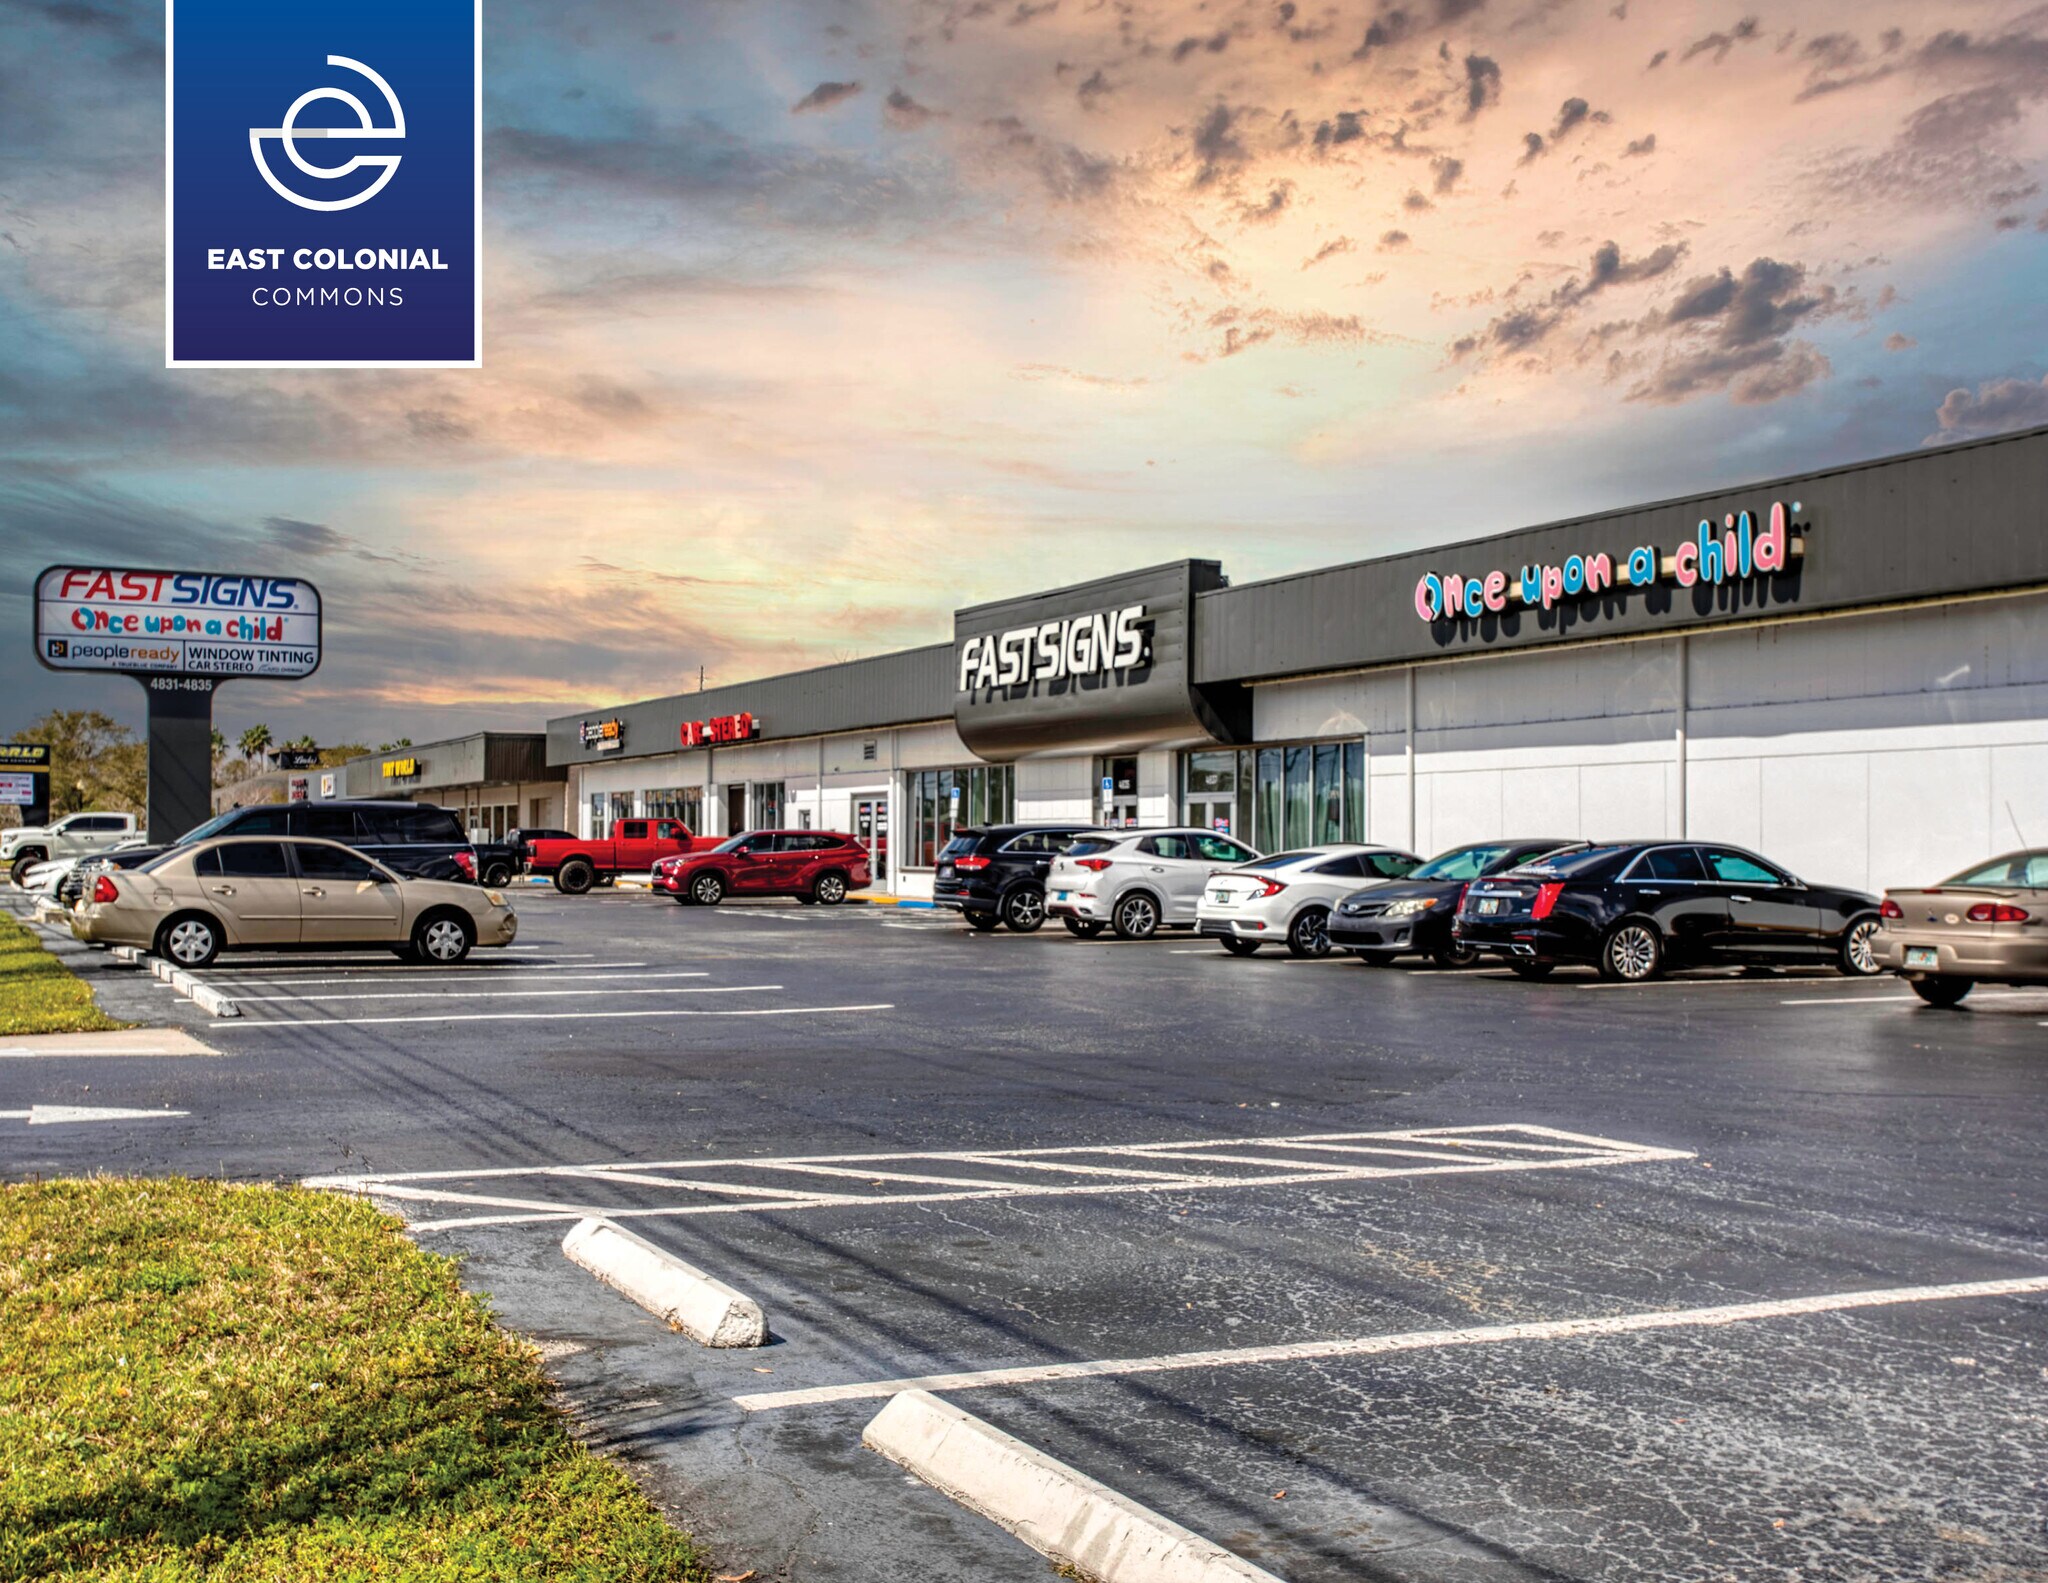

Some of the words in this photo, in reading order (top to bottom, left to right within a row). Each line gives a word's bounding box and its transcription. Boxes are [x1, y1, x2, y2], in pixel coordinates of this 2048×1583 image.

[1415, 572, 1506, 622] Once
[1520, 553, 1612, 609] upon
[1628, 545, 1656, 587] a
[1675, 501, 1786, 587] child
[60, 570, 297, 609] FASTSIGNS
[71, 607, 139, 633] Once
[144, 614, 201, 634] upon
[205, 619, 222, 635] a
[226, 615, 283, 641] child
[188, 647, 255, 661] WINDOW
[257, 650, 314, 664] TINTING
[959, 605, 1144, 692] FASTSIGNS
[188, 660, 210, 670] CAR
[213, 661, 254, 672] STEREO
[150, 677, 212, 691] 4831-4835
[680, 720, 704, 746] CAR
[709, 712, 752, 743] STEREO
